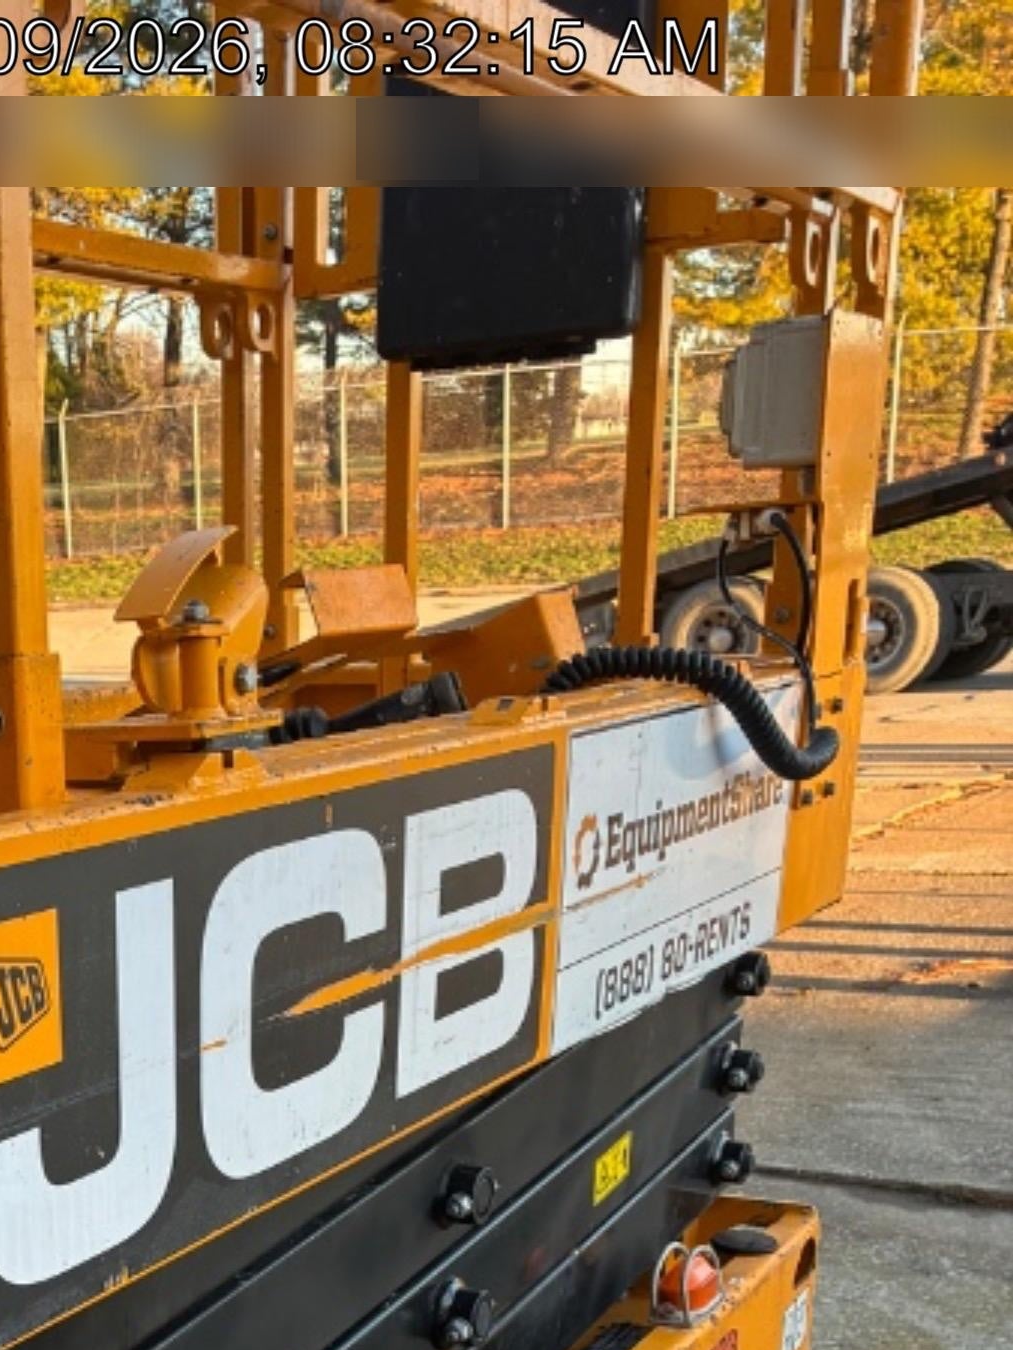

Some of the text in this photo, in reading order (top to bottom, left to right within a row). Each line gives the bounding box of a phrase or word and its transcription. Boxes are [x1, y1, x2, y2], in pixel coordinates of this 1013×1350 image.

[604, 770, 784, 873] EquipmentShare
[594, 901, 752, 1020] (888) 80-RENTS
